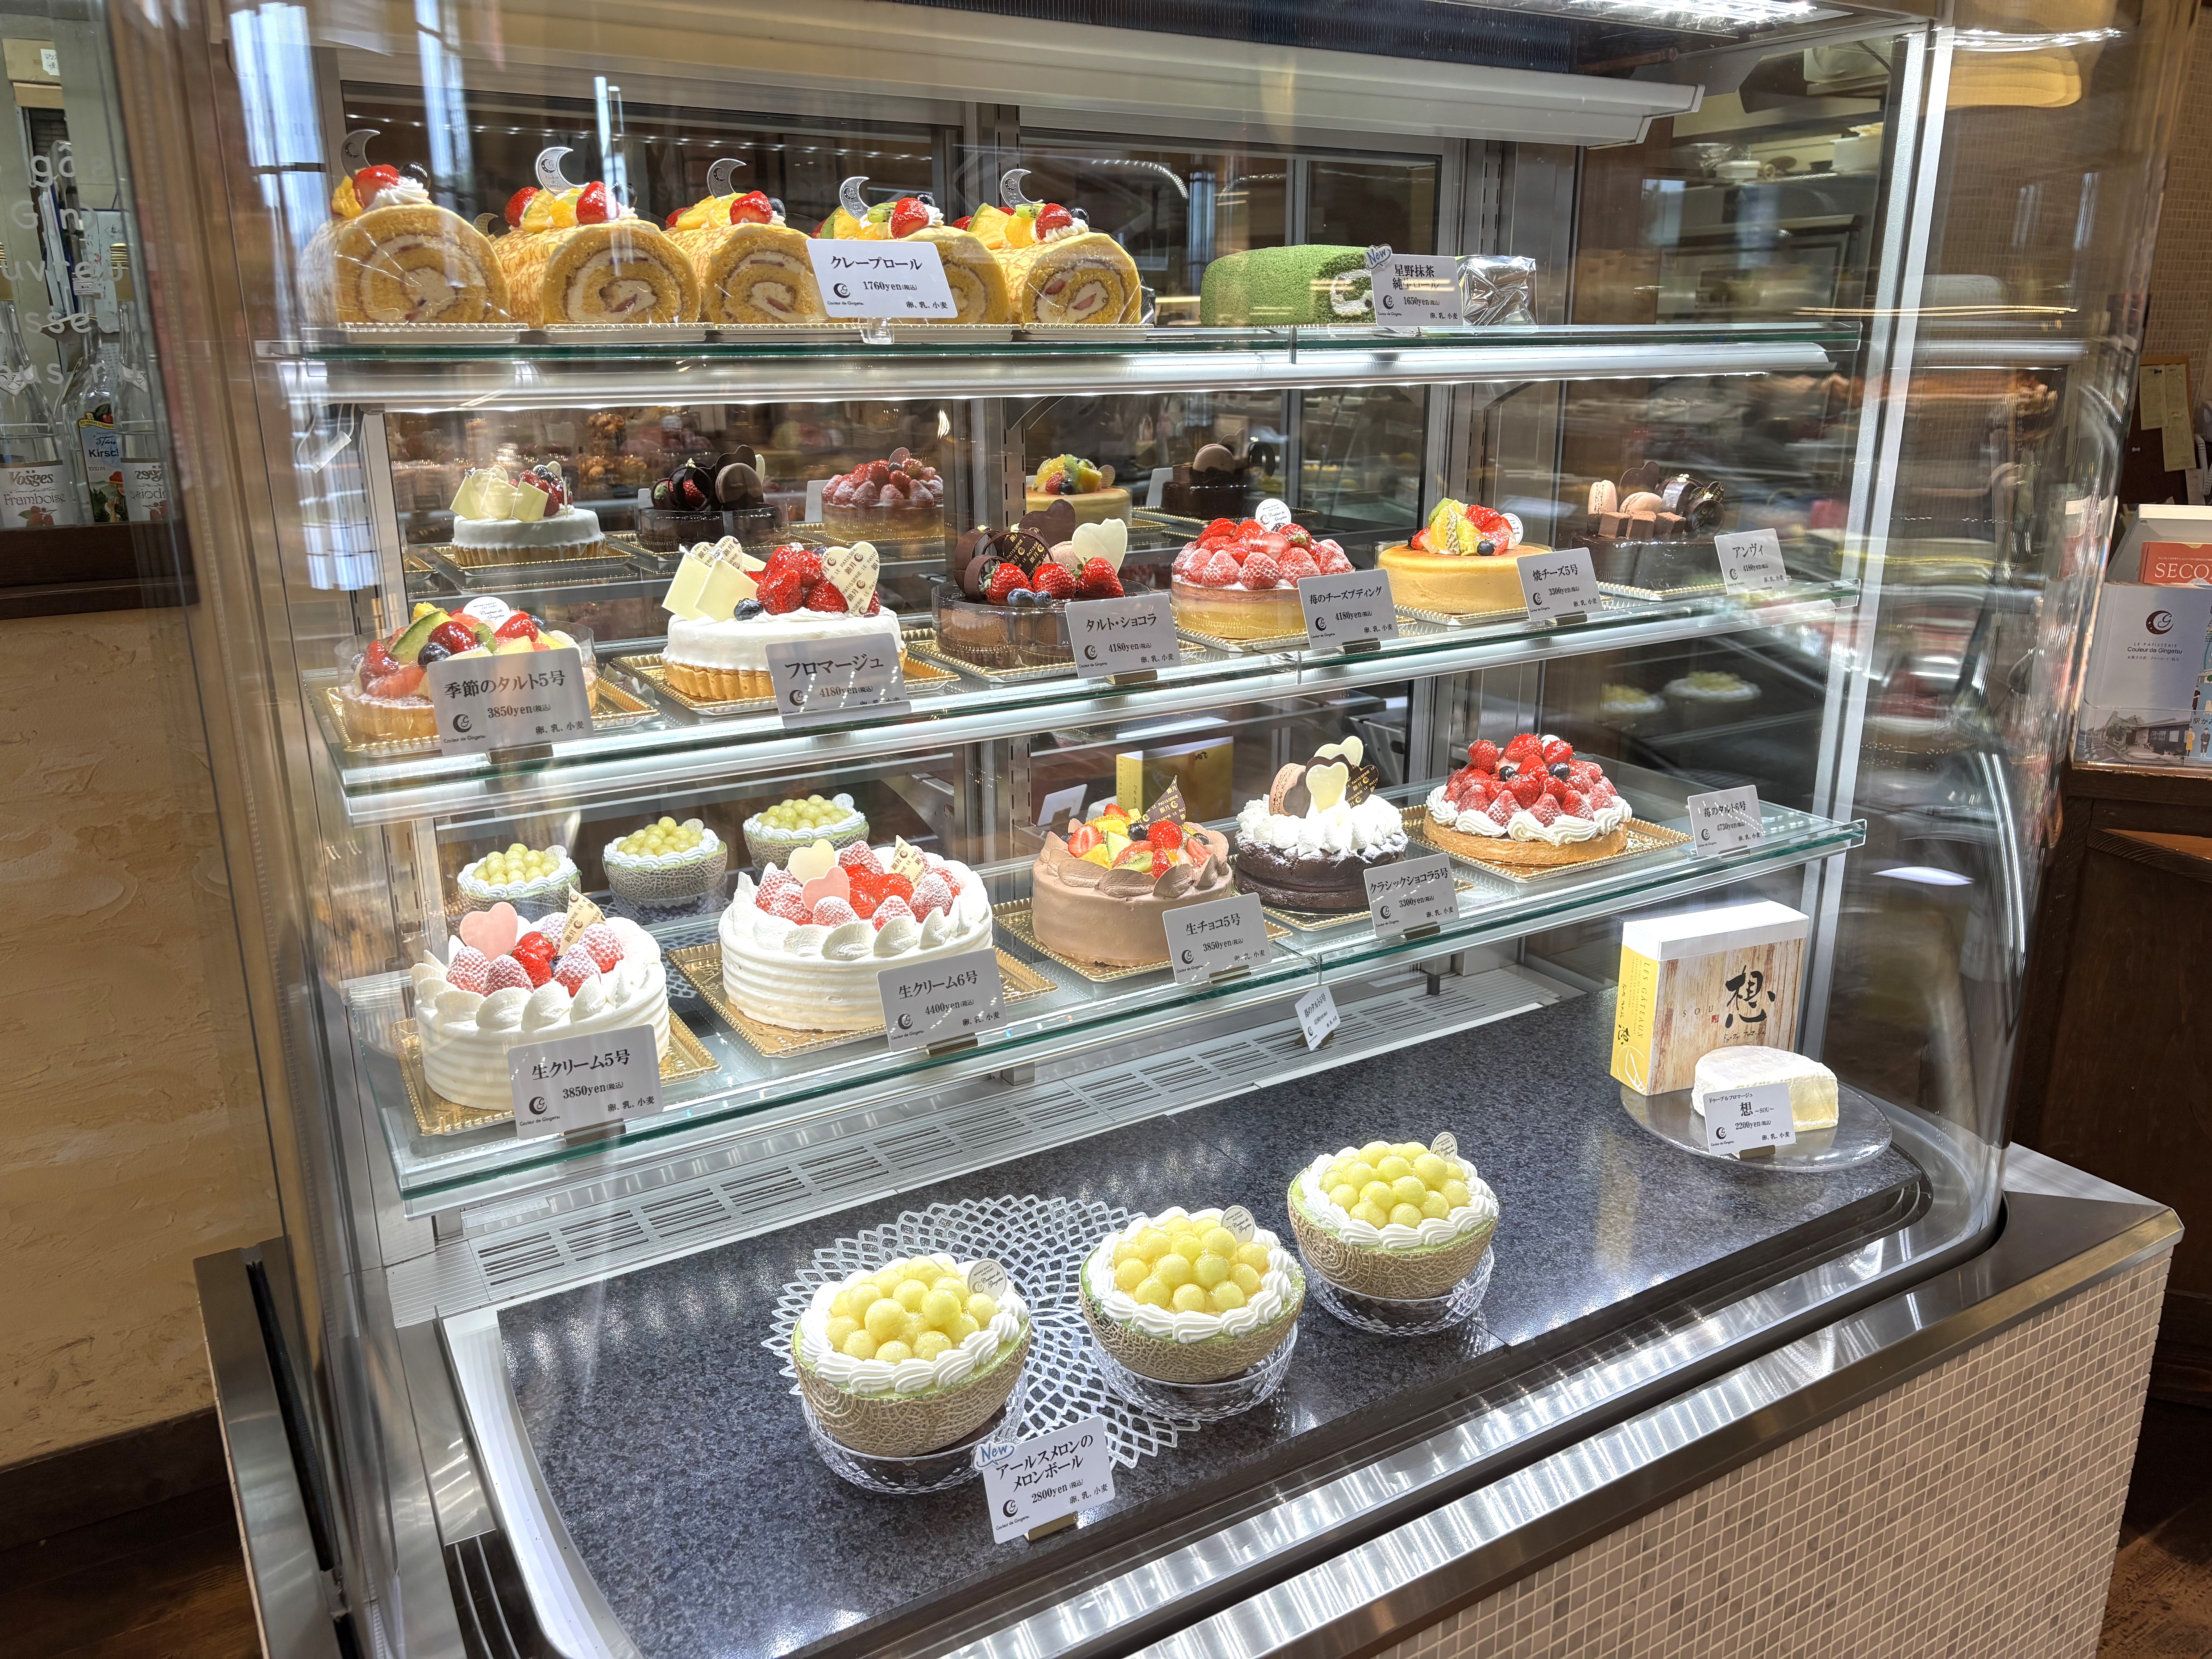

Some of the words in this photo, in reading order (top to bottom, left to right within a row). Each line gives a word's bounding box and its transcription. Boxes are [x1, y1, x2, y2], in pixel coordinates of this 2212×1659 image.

[831, 256, 922, 270] クレープロール
[1366, 249, 1386, 265] New
[1395, 264, 1434, 278] 星野抹茶
[862, 281, 917, 291] 1760yen(税込)
[1403, 296, 1440, 306] 1650yen(税込)
[8, 471, 53, 486] Vosges
[3, 493, 66, 505] Framboise
[1006, 539, 1023, 560] PATISSERIE
[1732, 543, 1763, 559] アンヴィ
[844, 562, 856, 575] 銀月
[1533, 564, 1578, 582] 焼チーズ5号
[842, 571, 862, 594] PATISSERIE
[847, 589, 859, 602] 銀月
[1548, 586, 1580, 596] 3300yen(税込)
[1573, 598, 1597, 608] 卵、乳、小麦
[1086, 613, 1157, 632] タルト・ショコラ
[1335, 611, 1372, 621] 4180yen(税込)
[1364, 623, 1393, 634] 卵、乳、小麦
[1108, 642, 1152, 653] 4180yen(税込)
[785, 654, 884, 679] フロマージュ
[1140, 653, 1174, 664] 卵、乳、小麦
[444, 670, 565, 699] 季節のタルト5号
[820, 686, 873, 697] 4180yen(税込)
[488, 704, 551, 718] 3850yen(税込)
[535, 721, 584, 735] 卵、乳、小麦
[1704, 801, 1746, 817] 苺のタルト6号
[1370, 867, 1448, 894] クラシックショコラ5号
[1399, 895, 1434, 908] 3300yen(税込)
[1426, 906, 1453, 918] 卵、乳、小麦
[1186, 913, 1240, 936] 生チョコ5号
[1203, 938, 1243, 951] 3850yen(税込)
[898, 970, 978, 1000] 生クリーム6号
[1725, 965, 1776, 1029] 想
[925, 999, 974, 1015] 4400yen(税込)
[1638, 988, 1647, 1039] GÂTEAUX
[962, 1011, 1000, 1027] 卵、乳、小麦
[1618, 1024, 1631, 1045] 想
[532, 1049, 630, 1080] 生クリーム5号
[563, 1081, 624, 1099] 3850yen(税込)
[1709, 1092, 1753, 1104] ドゥーブルフロマージュ
[608, 1096, 655, 1113] 卵、乳、小麦
[1740, 1102, 1753, 1116] 想
[1735, 1120, 1771, 1130] 2200yen(税込)
[1762, 1131, 1790, 1141] 卵、乳、小麦
[981, 1443, 1008, 1462] New
[996, 1435, 1093, 1480] アールスメロンの
[1013, 1455, 1083, 1492] メロンボール
[1032, 1484, 1068, 1504] 2800yen
[1070, 1479, 1083, 1489] (税込)
[1070, 1484, 1108, 1505] 卵、乳、小麦
